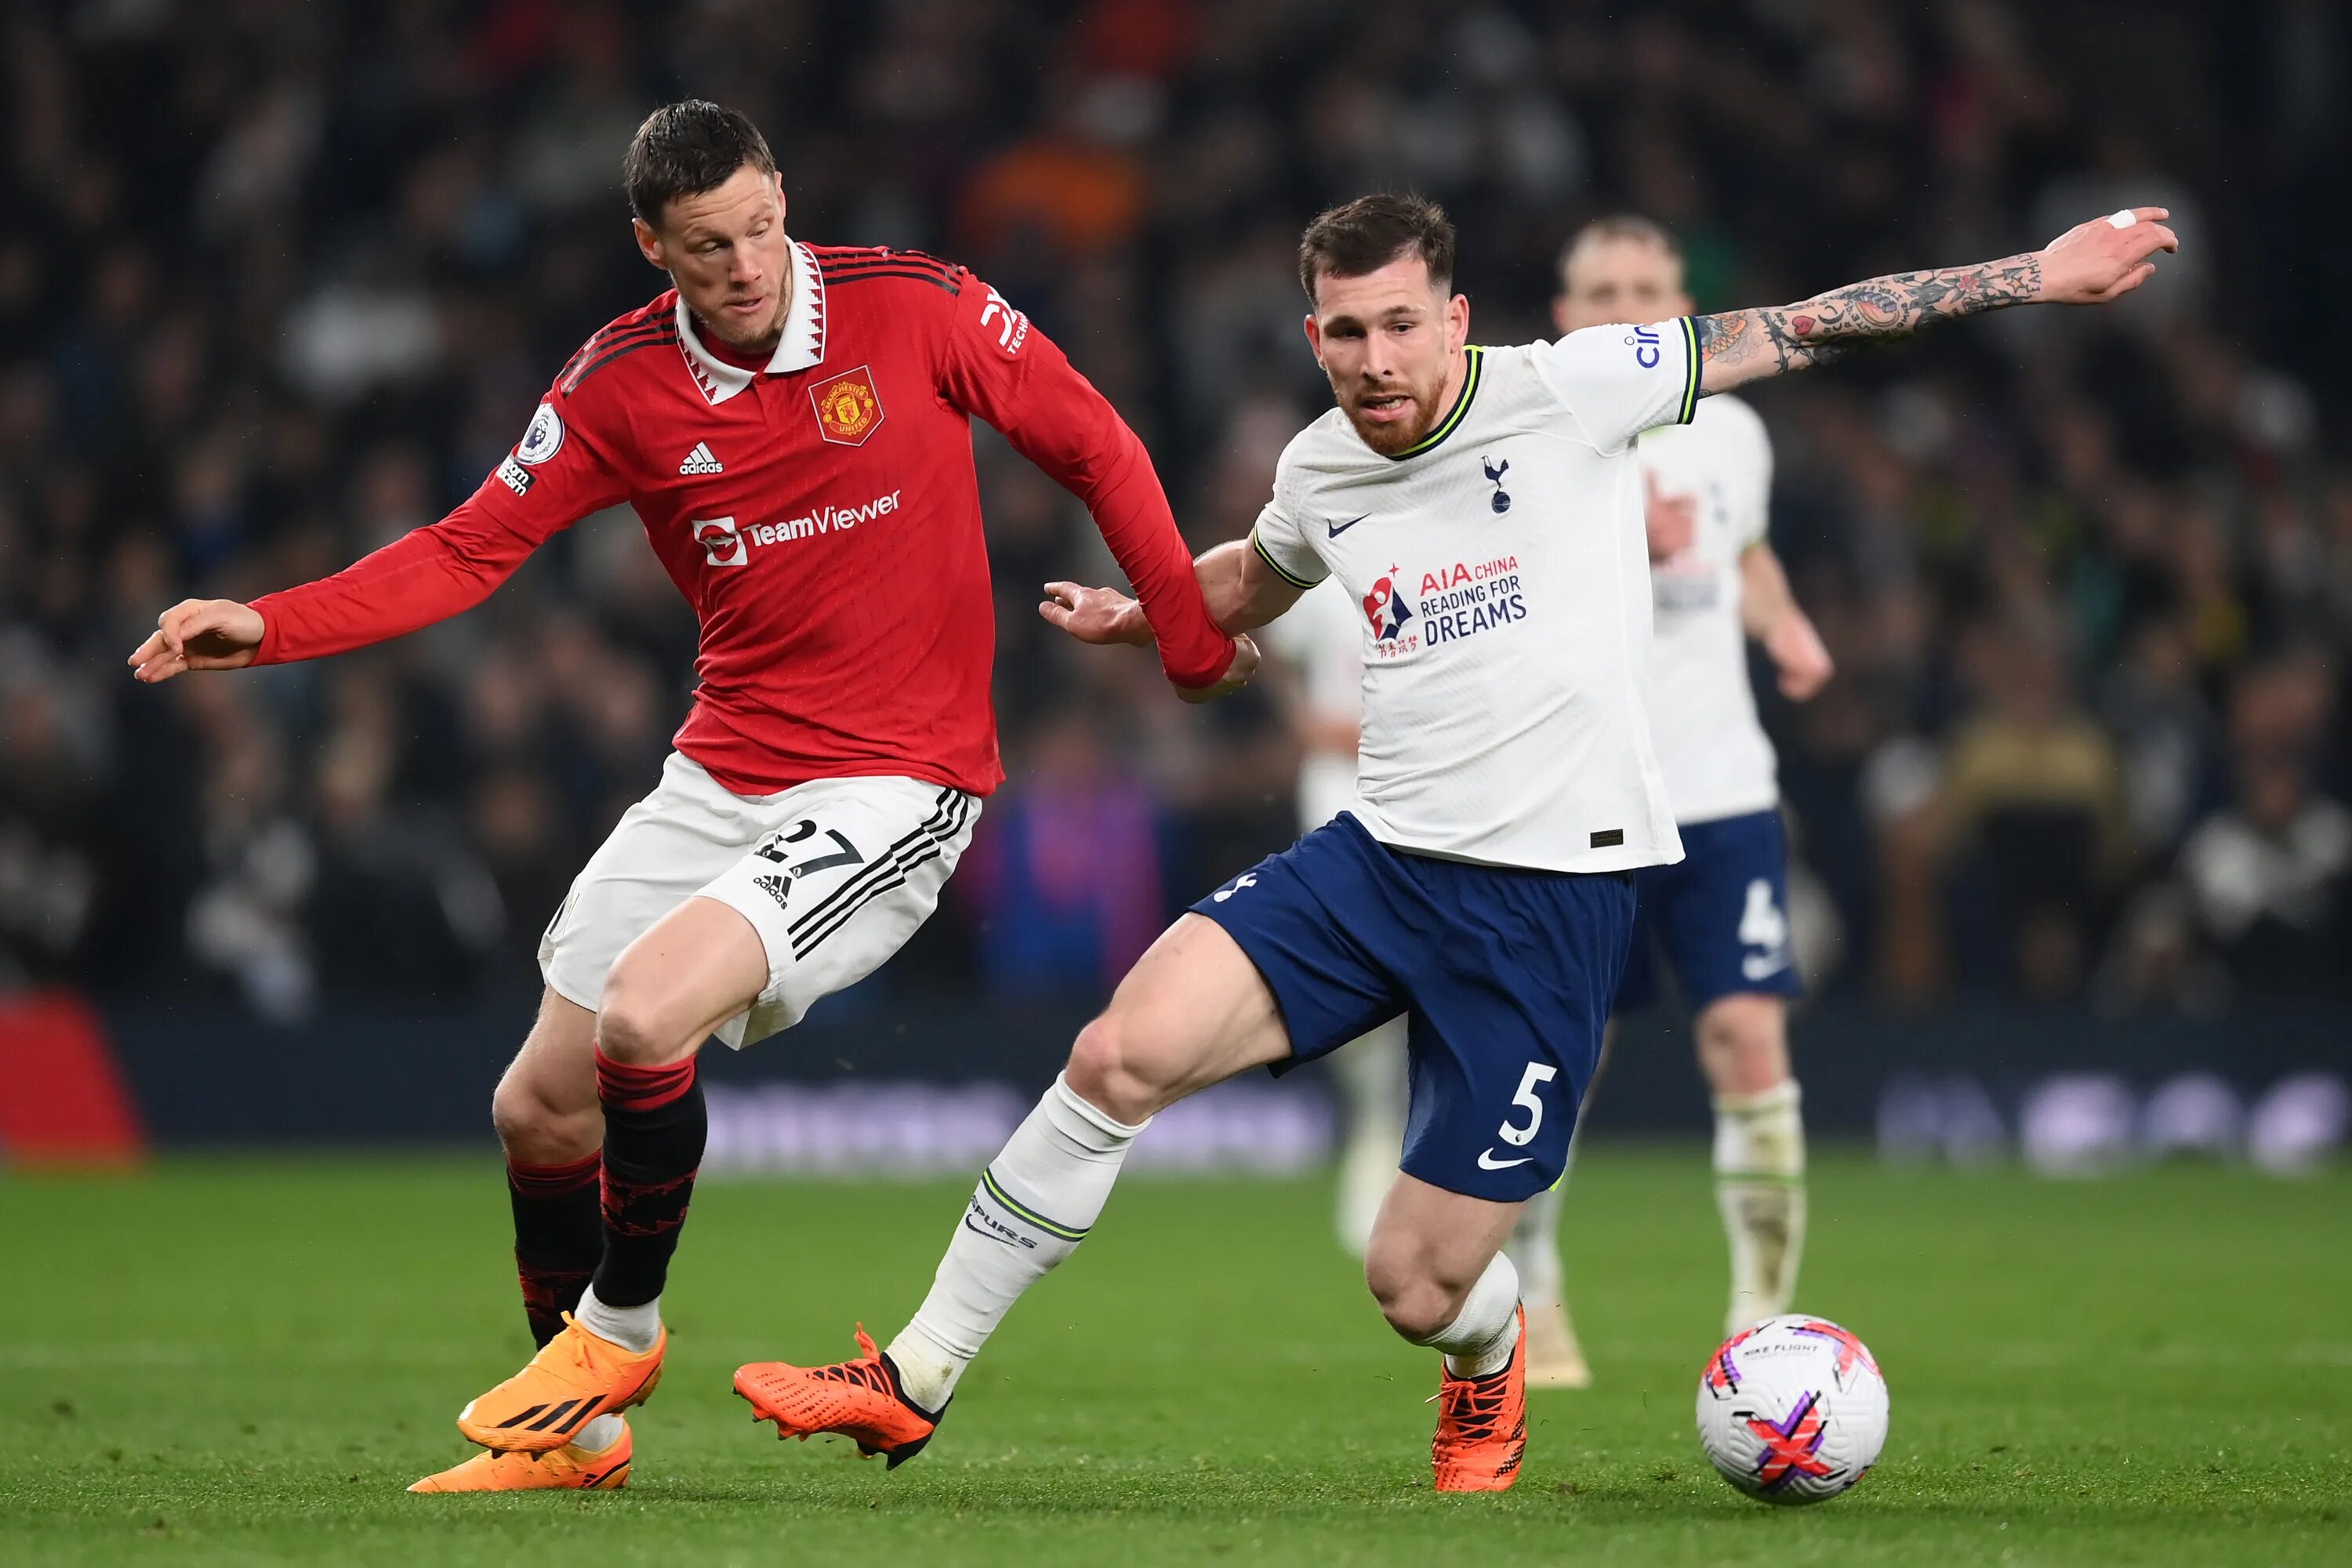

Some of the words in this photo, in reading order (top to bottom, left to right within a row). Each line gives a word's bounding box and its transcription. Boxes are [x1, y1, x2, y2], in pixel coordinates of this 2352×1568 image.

[825, 385, 865, 409] MANCHESTER
[839, 417, 867, 433] UNITED
[679, 461, 723, 474] adidas
[742, 489, 901, 547] TeamViewer
[1420, 563, 1472, 597] AIA
[1475, 556, 1519, 580] CHINA
[1421, 585, 1486, 618] READING
[1490, 575, 1521, 597] FOR
[1425, 593, 1527, 647] DREAMS
[753, 819, 865, 880] 27
[753, 876, 788, 910] adidas
[1737, 877, 1785, 949] 4
[1498, 1061, 1558, 1146] 5
[971, 1194, 1038, 1250] SPURS
